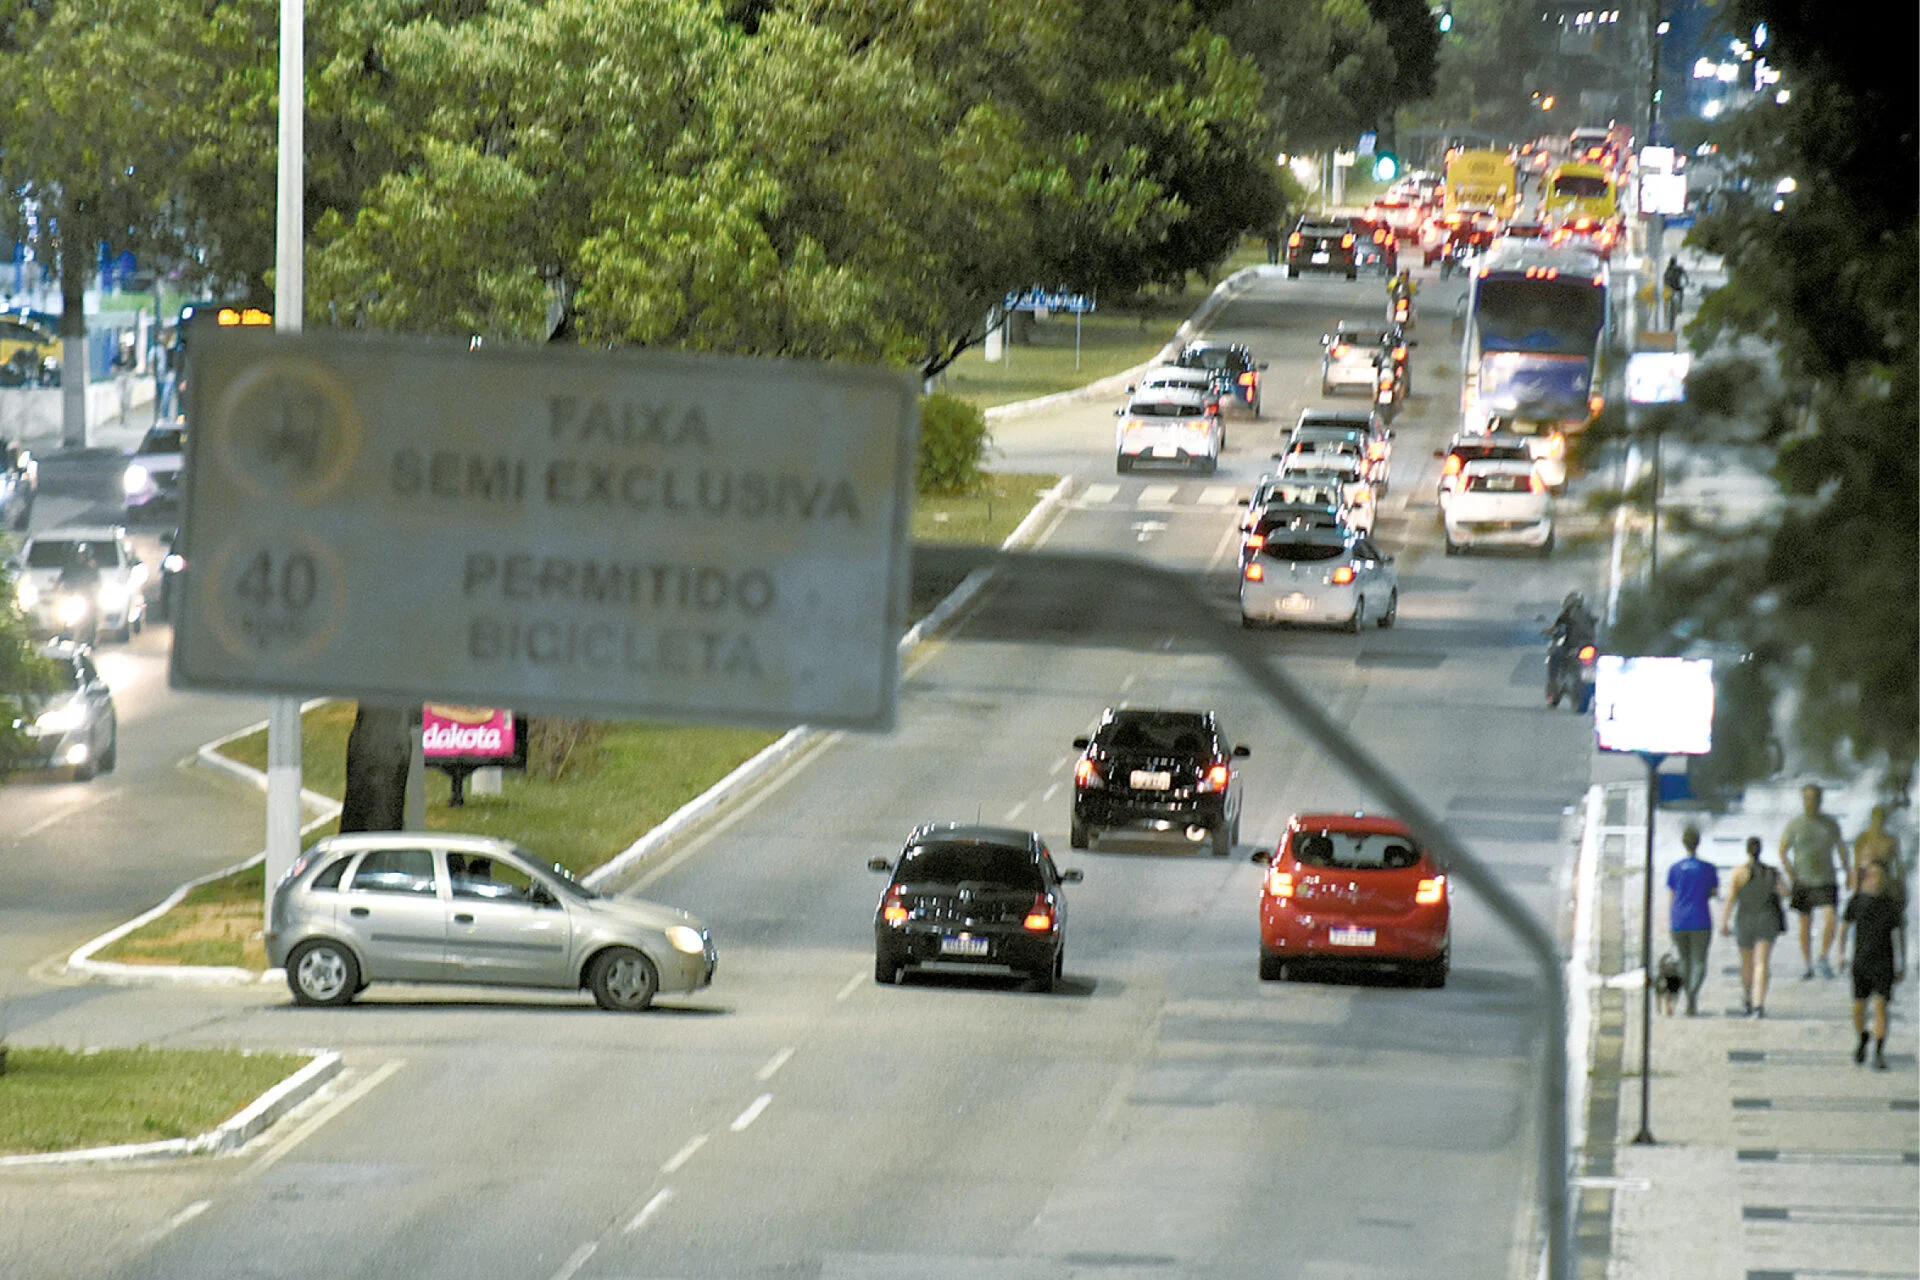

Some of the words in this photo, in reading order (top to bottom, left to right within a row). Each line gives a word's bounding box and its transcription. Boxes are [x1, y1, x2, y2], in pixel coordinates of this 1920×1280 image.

[546, 396, 711, 448] FAIXA
[391, 448, 525, 501] SEMI
[544, 459, 863, 524] EXCLUSIVA
[235, 549, 319, 613] 40
[463, 552, 778, 616] PERMITIDO
[468, 618, 763, 681] BICICLETA
[422, 723, 501, 750] dakota
